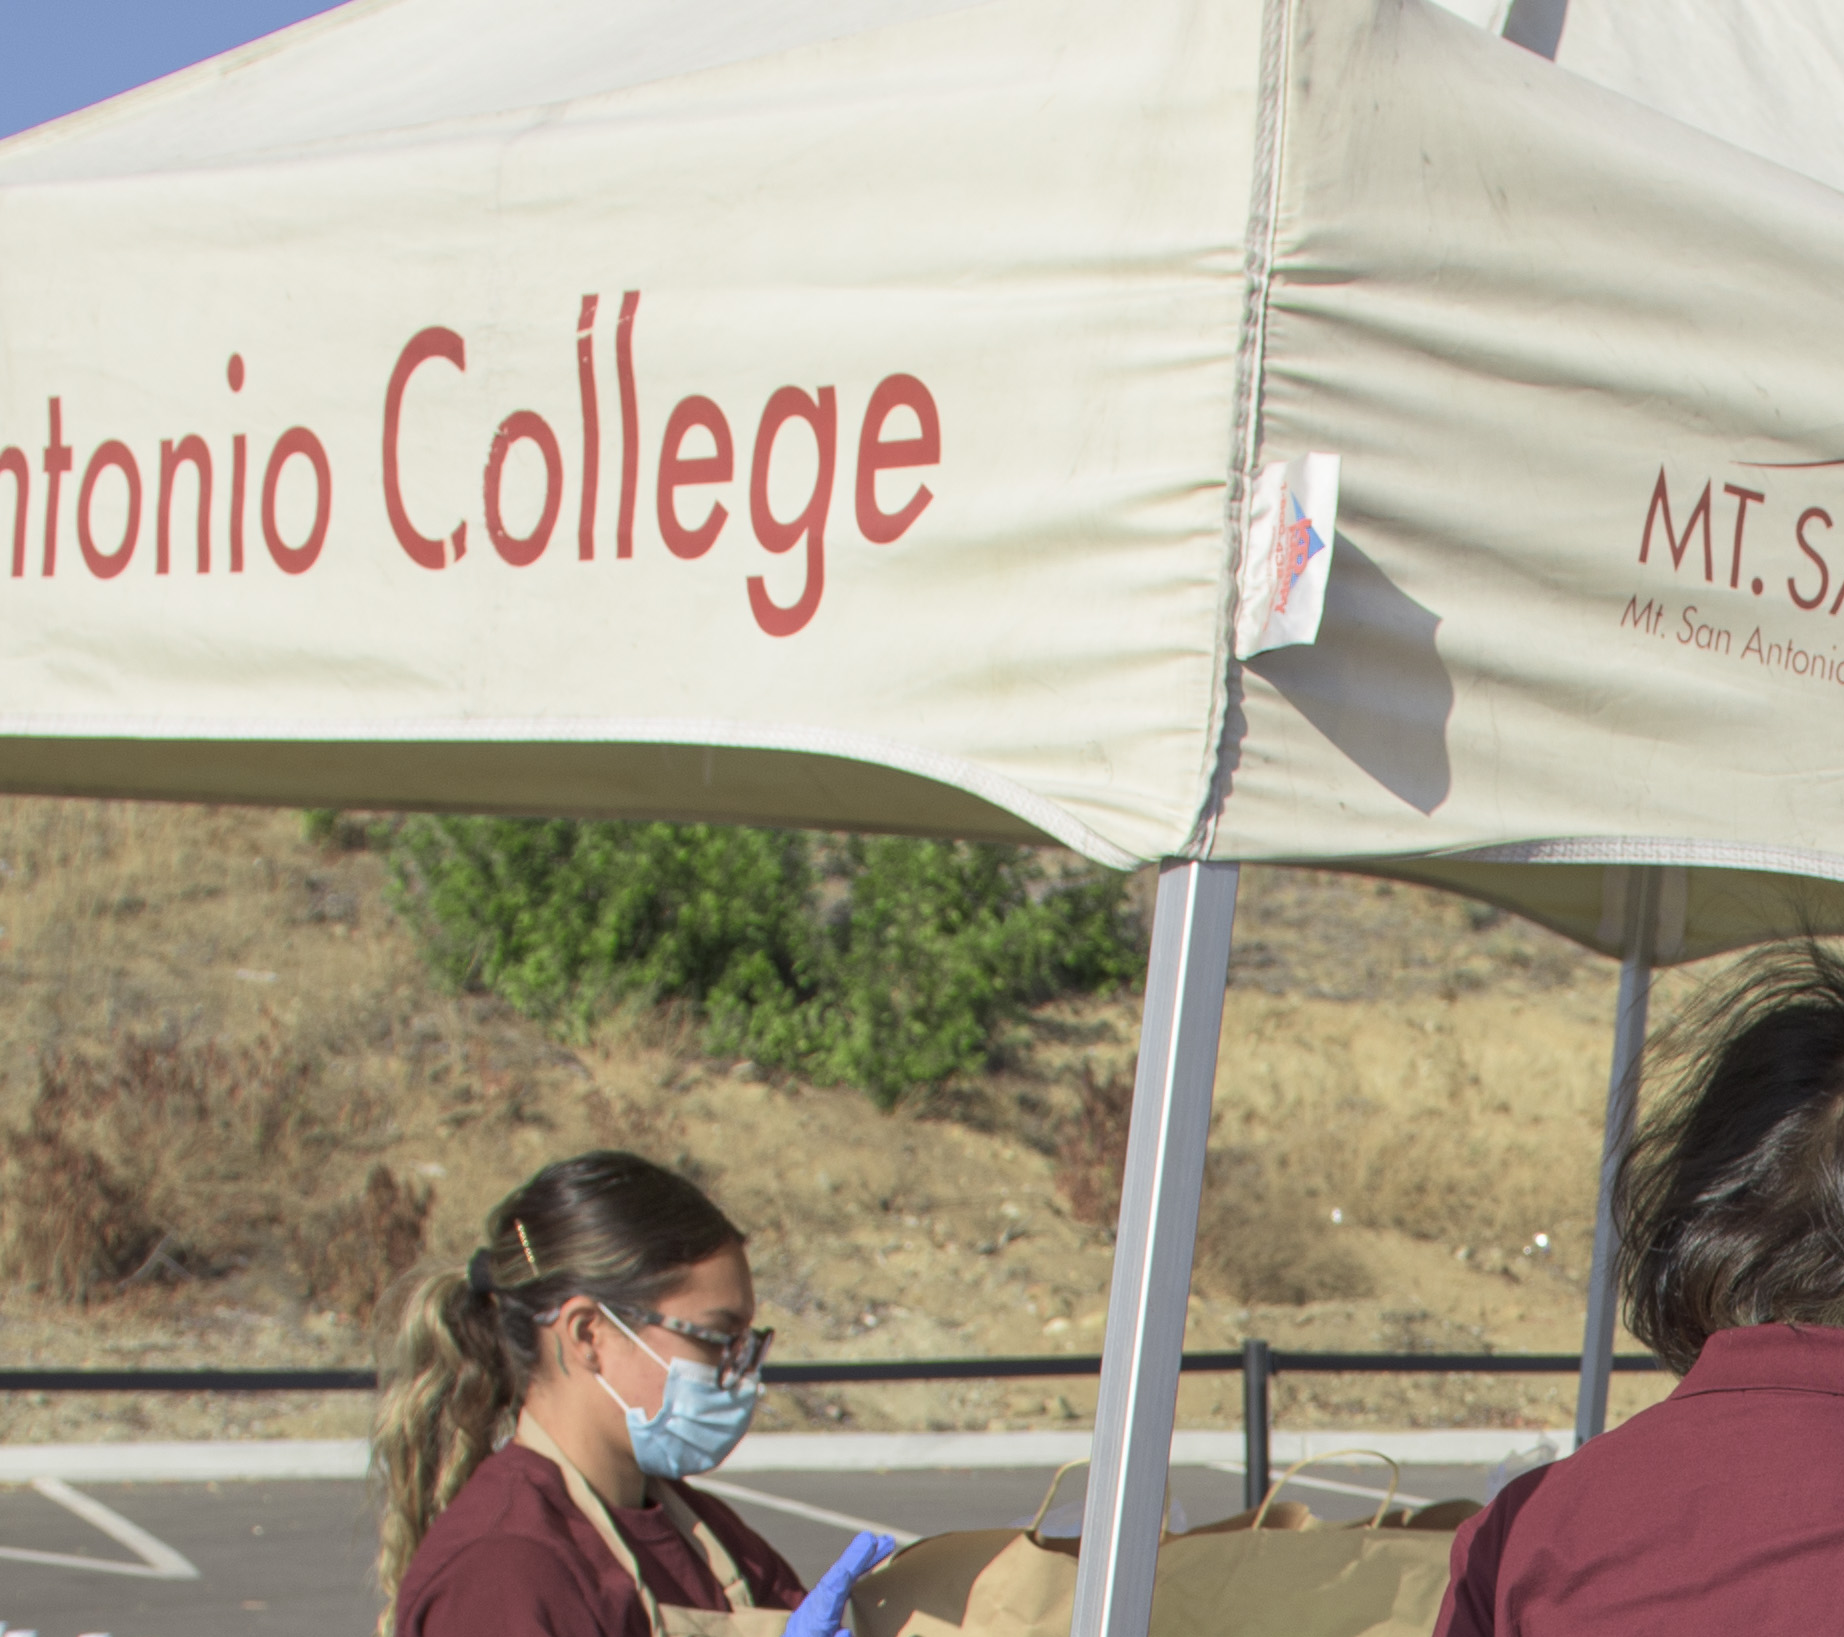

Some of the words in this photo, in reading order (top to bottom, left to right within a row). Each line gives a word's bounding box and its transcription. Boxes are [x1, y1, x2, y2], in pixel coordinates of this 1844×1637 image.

[381, 290, 940, 637] College
[1639, 466, 1765, 595] MT.
[1620, 594, 1666, 638] Mt.
[1676, 605, 1732, 656] San
